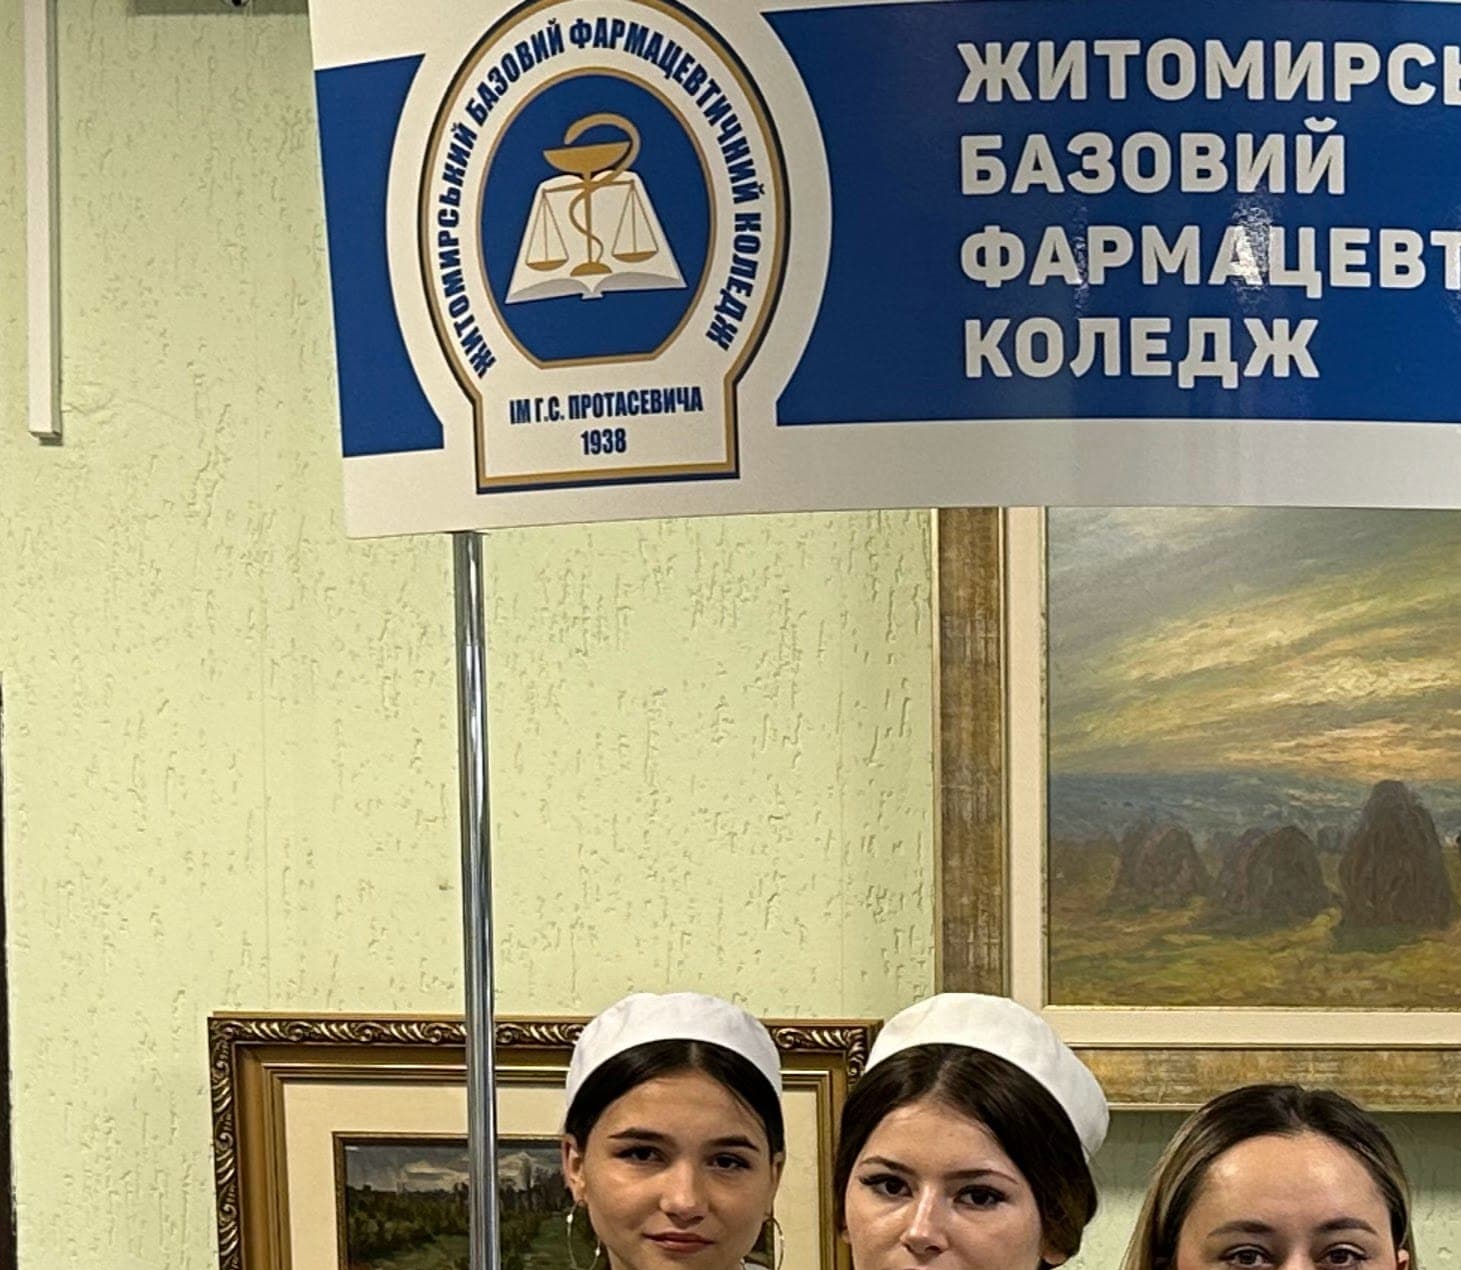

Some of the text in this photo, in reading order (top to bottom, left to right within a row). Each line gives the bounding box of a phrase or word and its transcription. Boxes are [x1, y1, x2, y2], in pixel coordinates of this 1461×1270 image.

[959, 117, 1346, 196] БАЗОВИЙ
[438, 17, 765, 379] ЖИТОМИРСЬКИЙ БАЗОВИЙ ФАРМАЦЕВТИЧНИЙ КОЛЕДЖ
[964, 317, 1320, 389] КОЛЕДЖ
[509, 386, 703, 424] ІМ Г.С. ПРОТАСЕВИЧА
[580, 428, 626, 455] 1938
